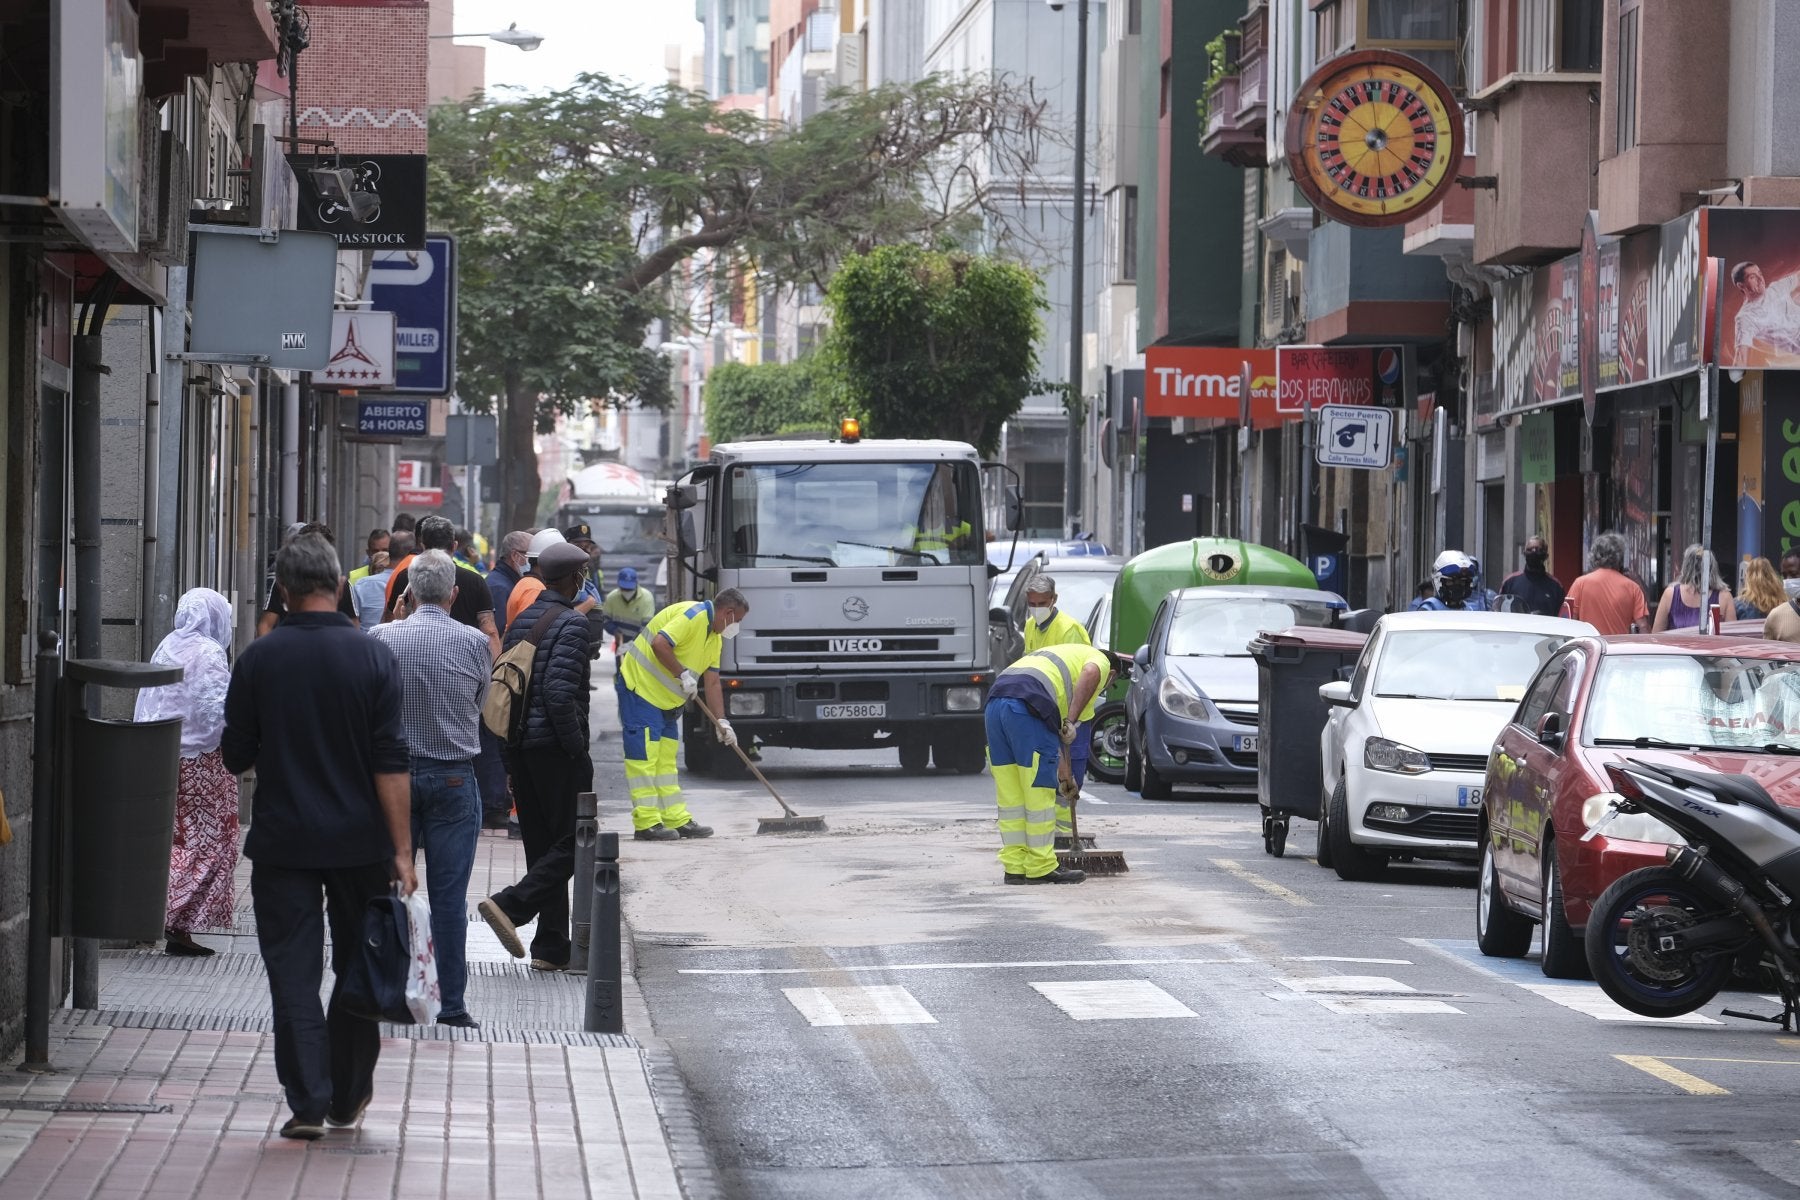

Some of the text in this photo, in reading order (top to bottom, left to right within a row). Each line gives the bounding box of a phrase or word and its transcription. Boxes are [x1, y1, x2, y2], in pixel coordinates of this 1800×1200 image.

[361, 233, 406, 243] STOCK
[1646, 209, 1700, 380] Winners
[282, 334, 305, 348] HVK
[396, 333, 435, 347] MILLER
[1153, 367, 1241, 397] Tirma
[1281, 378, 1372, 406] DOS HERMANAS
[364, 406, 421, 417] ABIERTO
[1357, 411, 1383, 419] Puerto
[360, 420, 425, 430] 24 HORAS
[1317, 556, 1331, 576] P
[828, 639, 883, 652] IVECO
[823, 705, 884, 718] GC7588CJ
